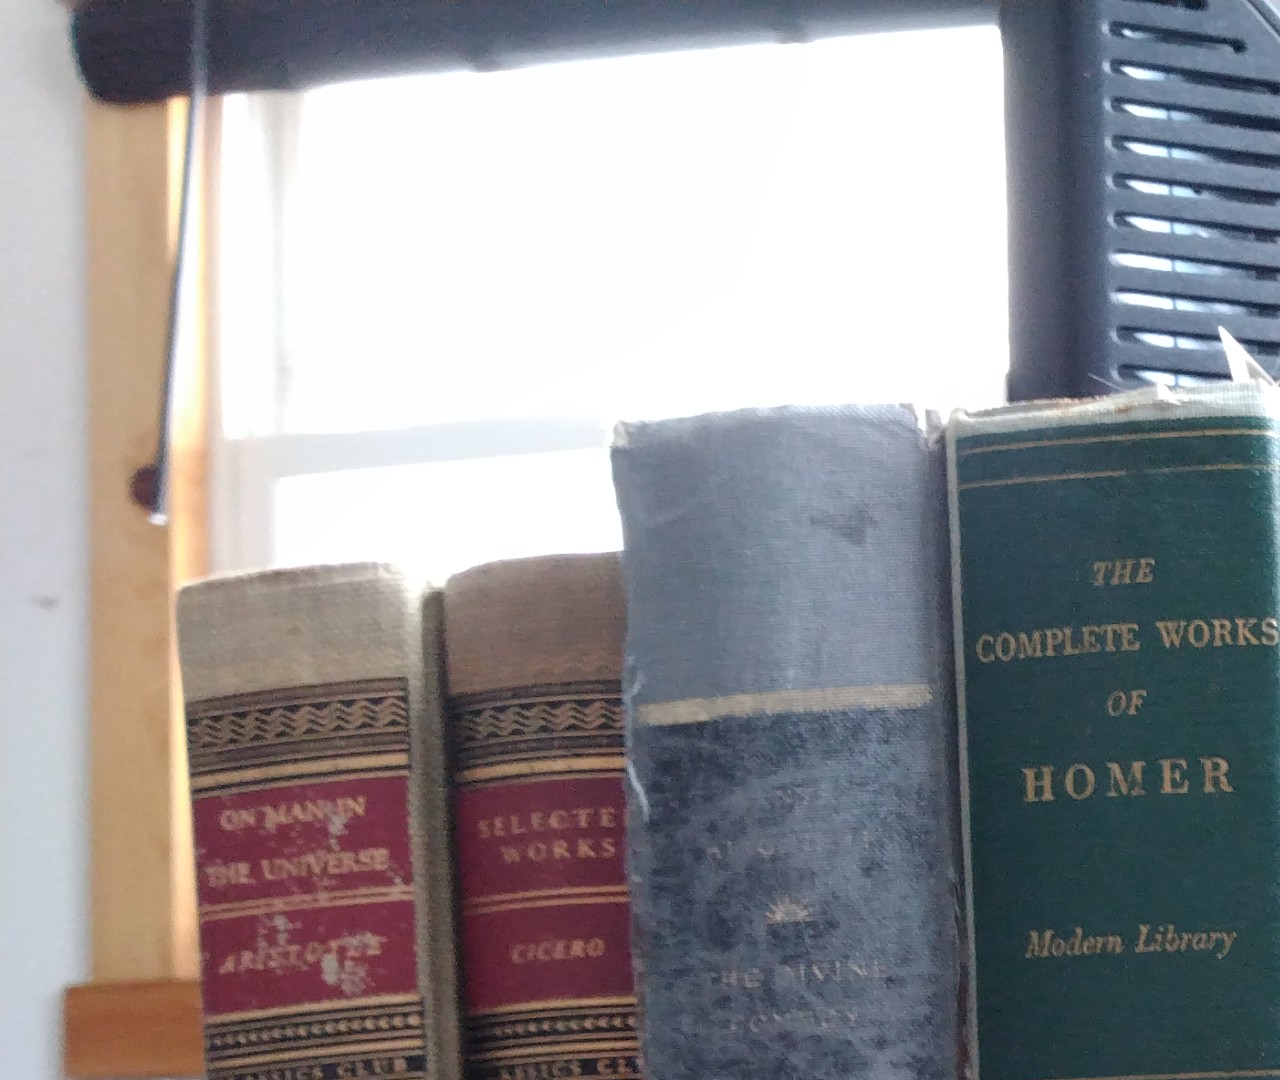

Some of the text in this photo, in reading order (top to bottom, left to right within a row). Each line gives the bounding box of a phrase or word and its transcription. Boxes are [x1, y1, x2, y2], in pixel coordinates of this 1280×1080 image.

[1093, 557, 1156, 586] THE
[975, 618, 1280, 664] COMPLETE WORKS
[1106, 689, 1147, 717] OF
[1021, 756, 1235, 803] HOMER
[476, 806, 618, 838] SELECTE
[261, 848, 391, 880] UNIVERSE
[501, 837, 616, 863] WORKS
[509, 937, 606, 965] CICERO
[1024, 925, 1238, 961] Modern Library
